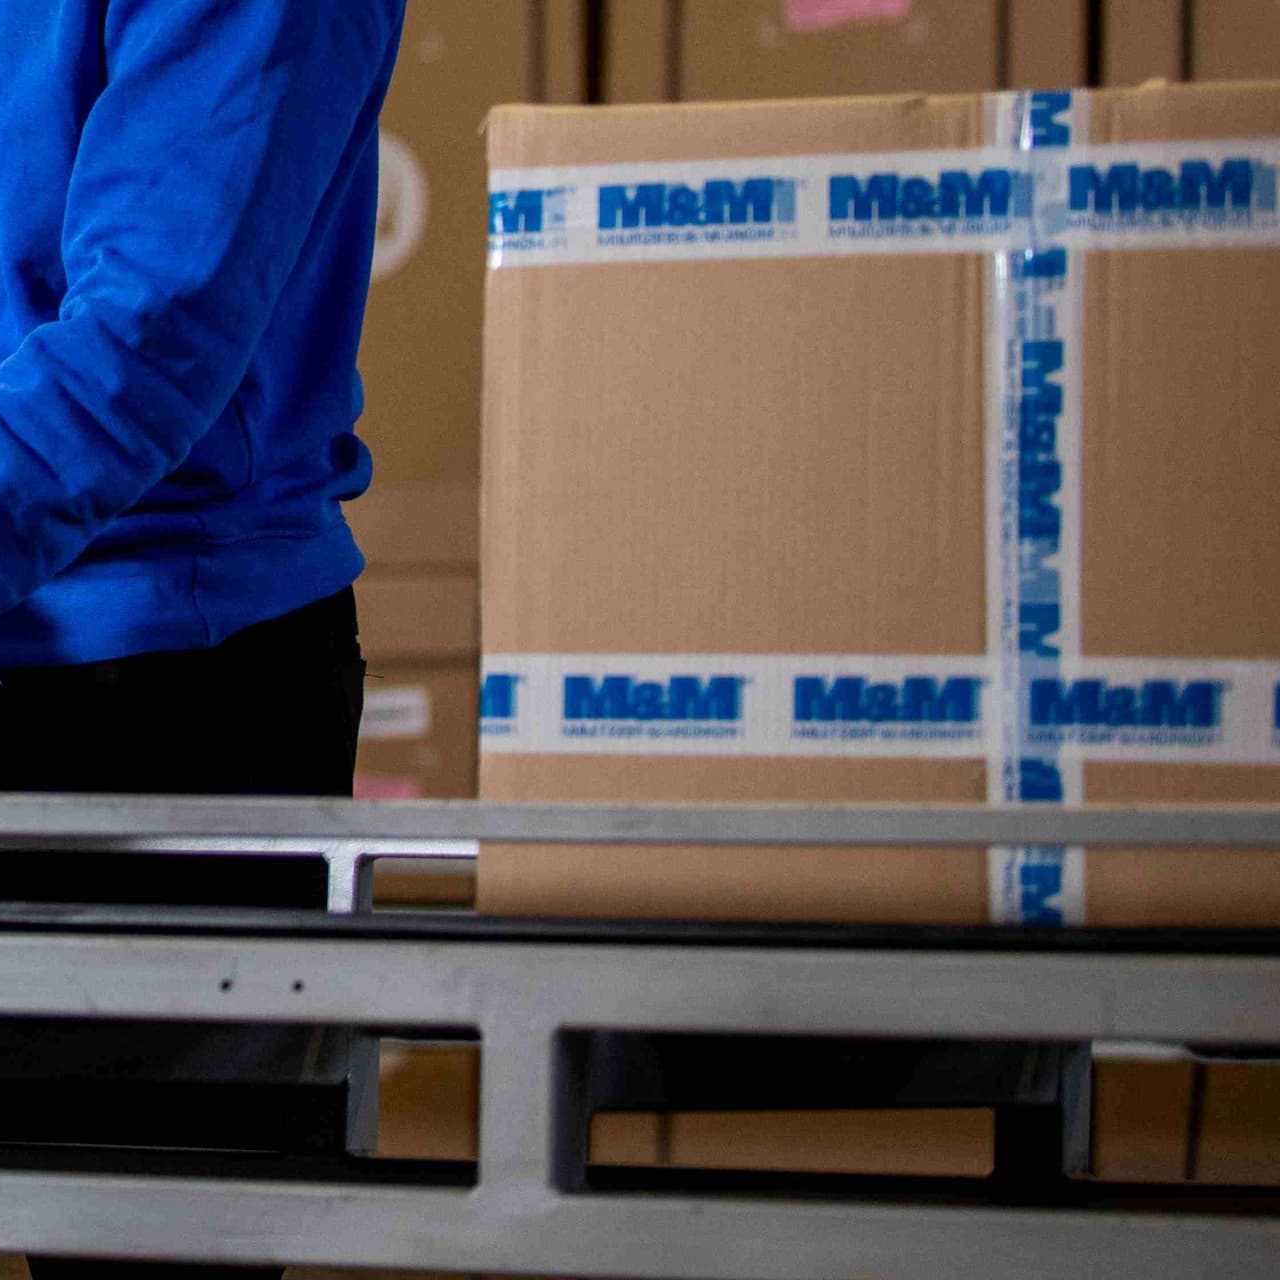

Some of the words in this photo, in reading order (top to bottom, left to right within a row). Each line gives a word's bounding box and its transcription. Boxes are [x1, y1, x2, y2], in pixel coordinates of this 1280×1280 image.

[597, 178, 775, 229] M&M
[828, 168, 1011, 220] M&M
[1068, 157, 1251, 211] M&M
[1019, 340, 1064, 538] M&M
[563, 675, 742, 721] M&M
[794, 676, 980, 723] M&M
[1029, 678, 1221, 728] M&M
